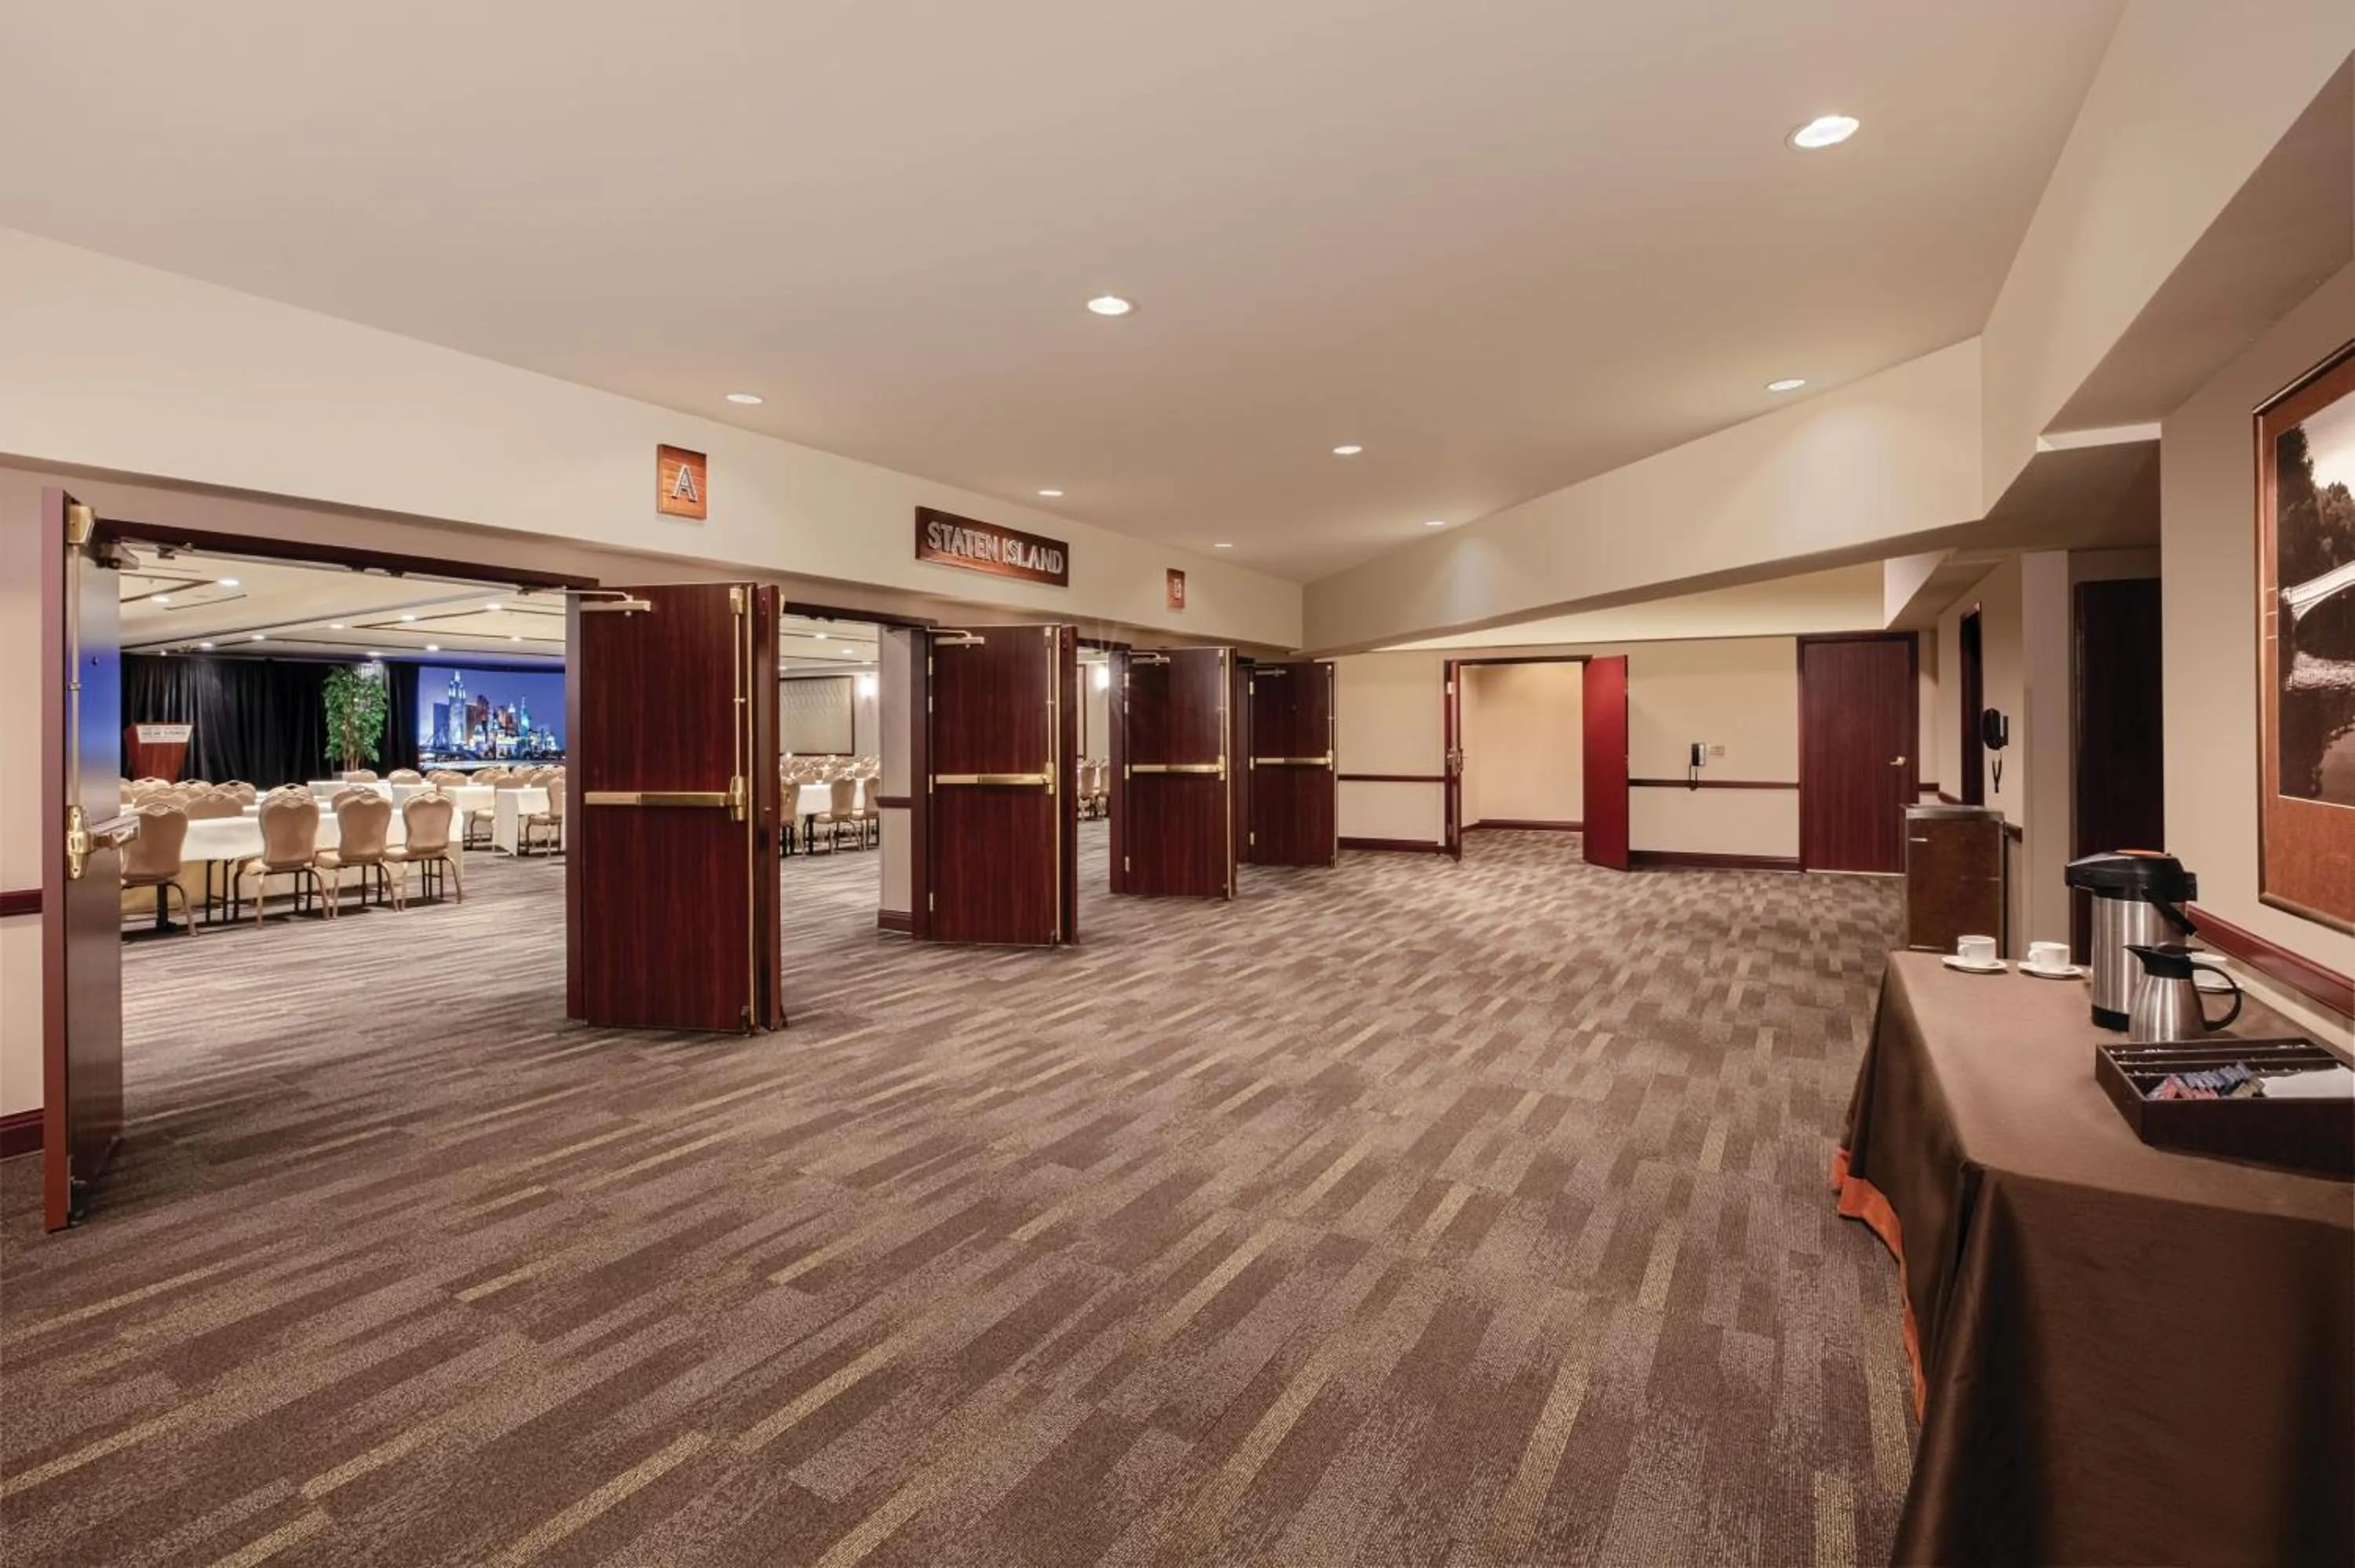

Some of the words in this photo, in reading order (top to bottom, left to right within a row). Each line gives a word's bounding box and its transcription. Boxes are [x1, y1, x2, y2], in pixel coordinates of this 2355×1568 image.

[673, 465, 697, 501] A
[927, 521, 999, 561] STATEN
[1002, 538, 1063, 574] ISLAND
